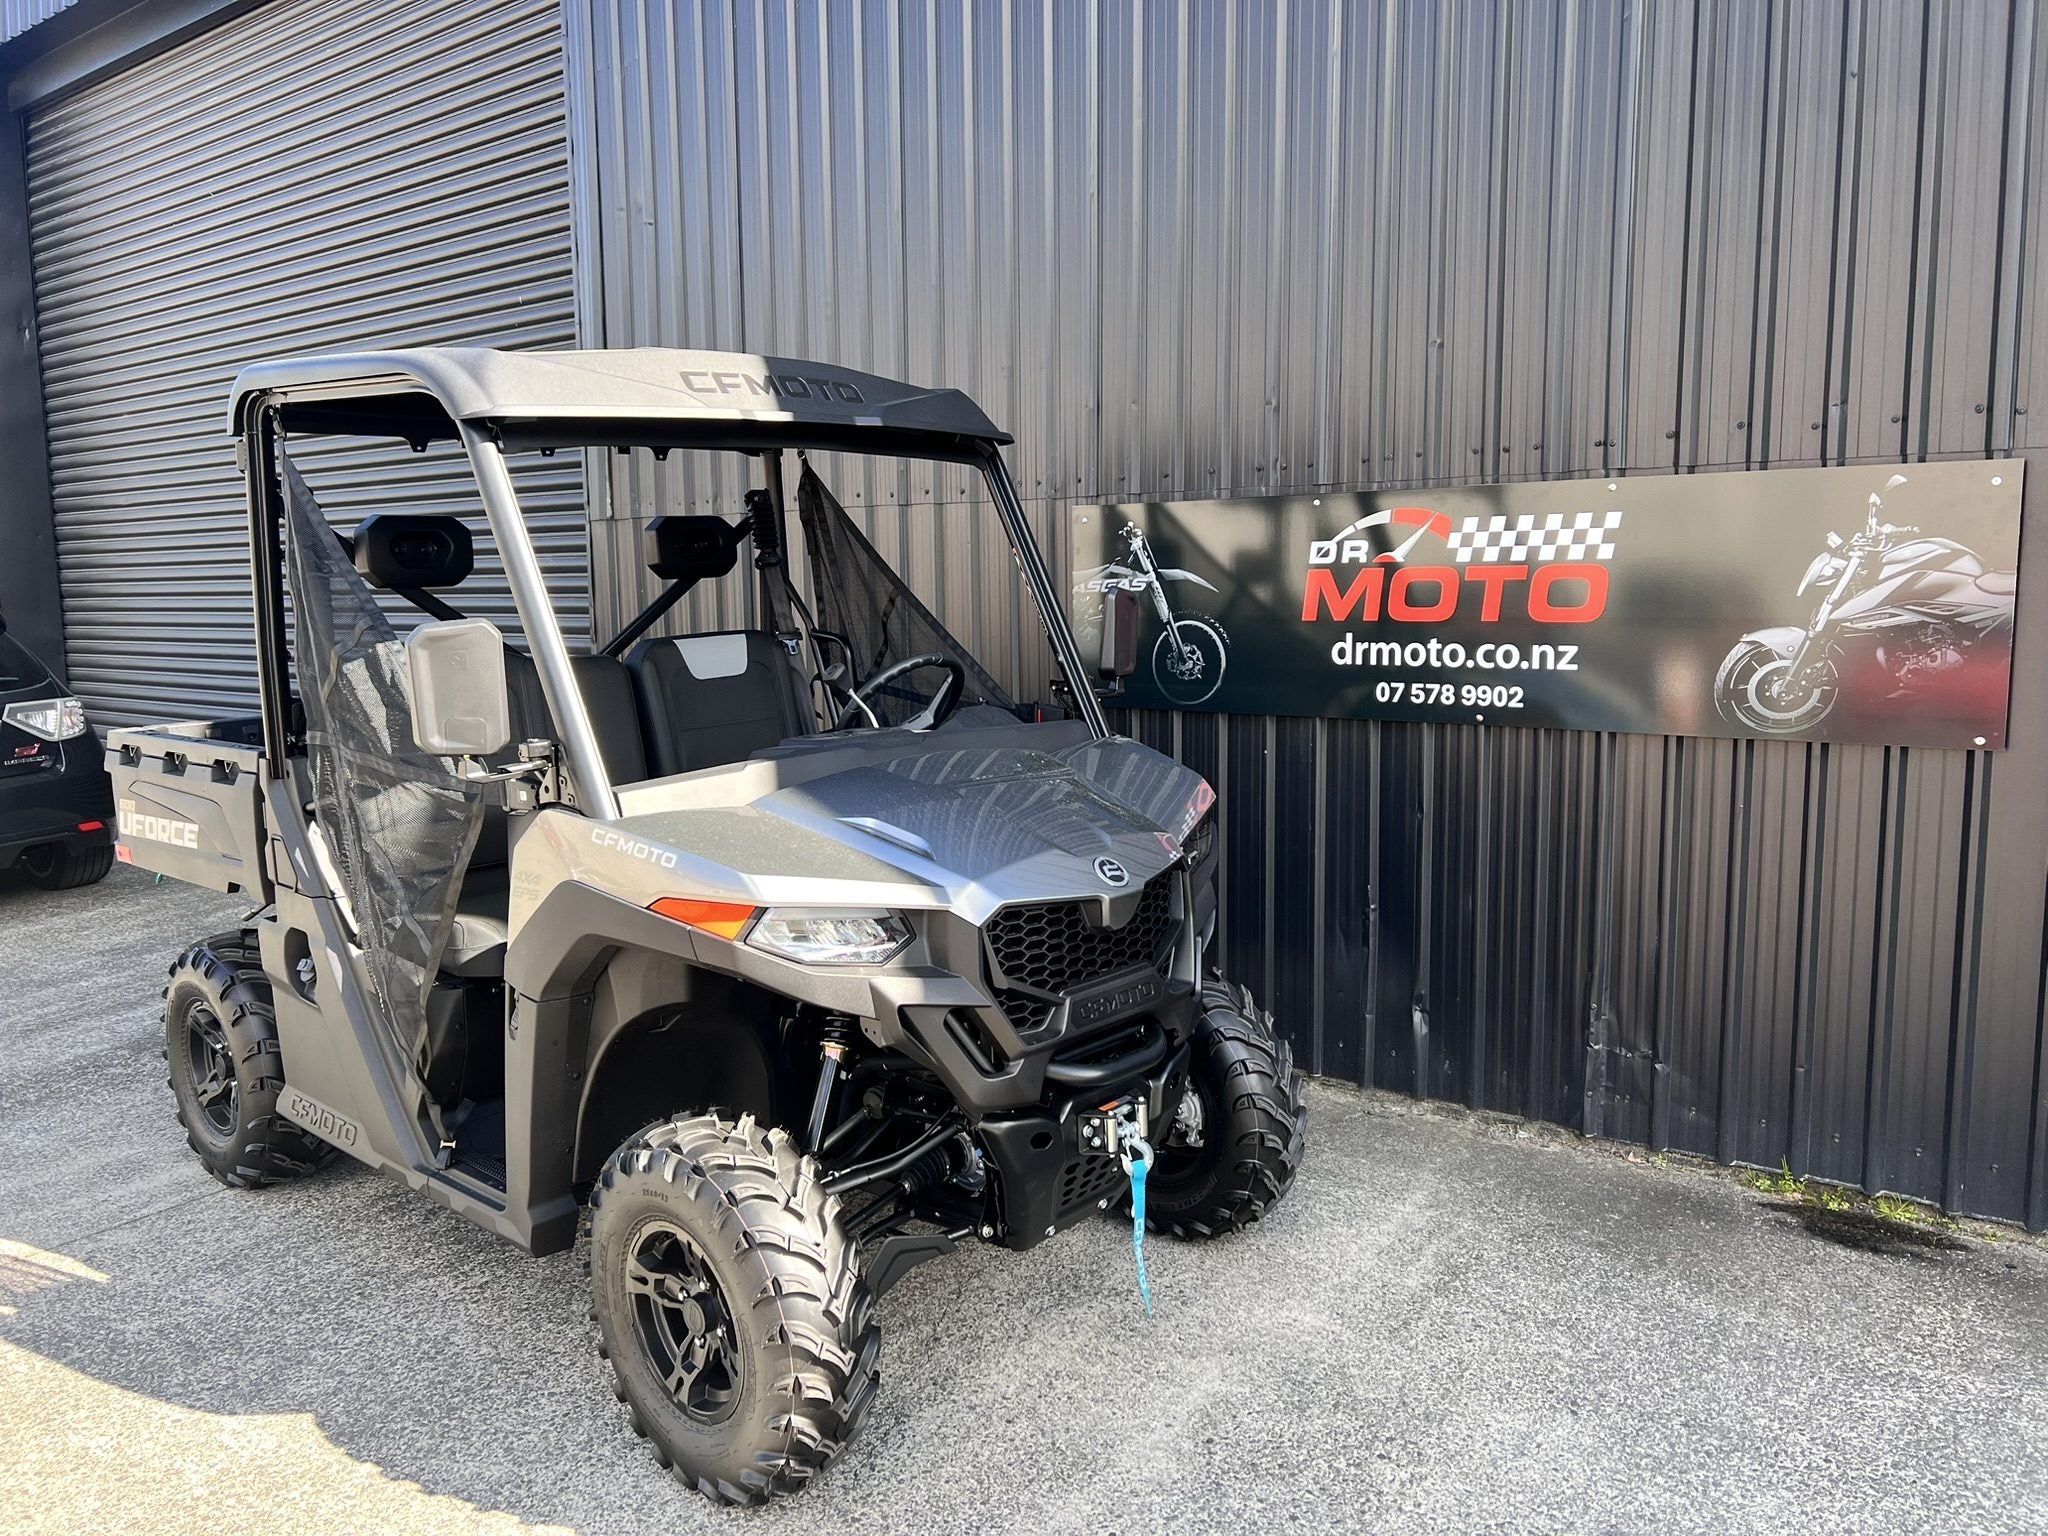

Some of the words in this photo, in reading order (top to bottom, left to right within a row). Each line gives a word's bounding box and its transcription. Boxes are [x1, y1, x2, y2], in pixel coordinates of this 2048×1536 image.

[679, 370, 865, 405] CFMOTO
[1308, 539, 1370, 565] DR
[1301, 563, 1610, 623] MOTO
[1331, 632, 1579, 671] drmoto.co.nz
[1375, 681, 1405, 703] 07
[1410, 683, 1456, 705] 578
[1461, 684, 1524, 709] 9902
[119, 811, 199, 850] UFORCE
[590, 828, 678, 869] CFMOTO
[1080, 983, 1155, 1020] CFMOTO
[291, 1093, 358, 1147] CFMOTO
